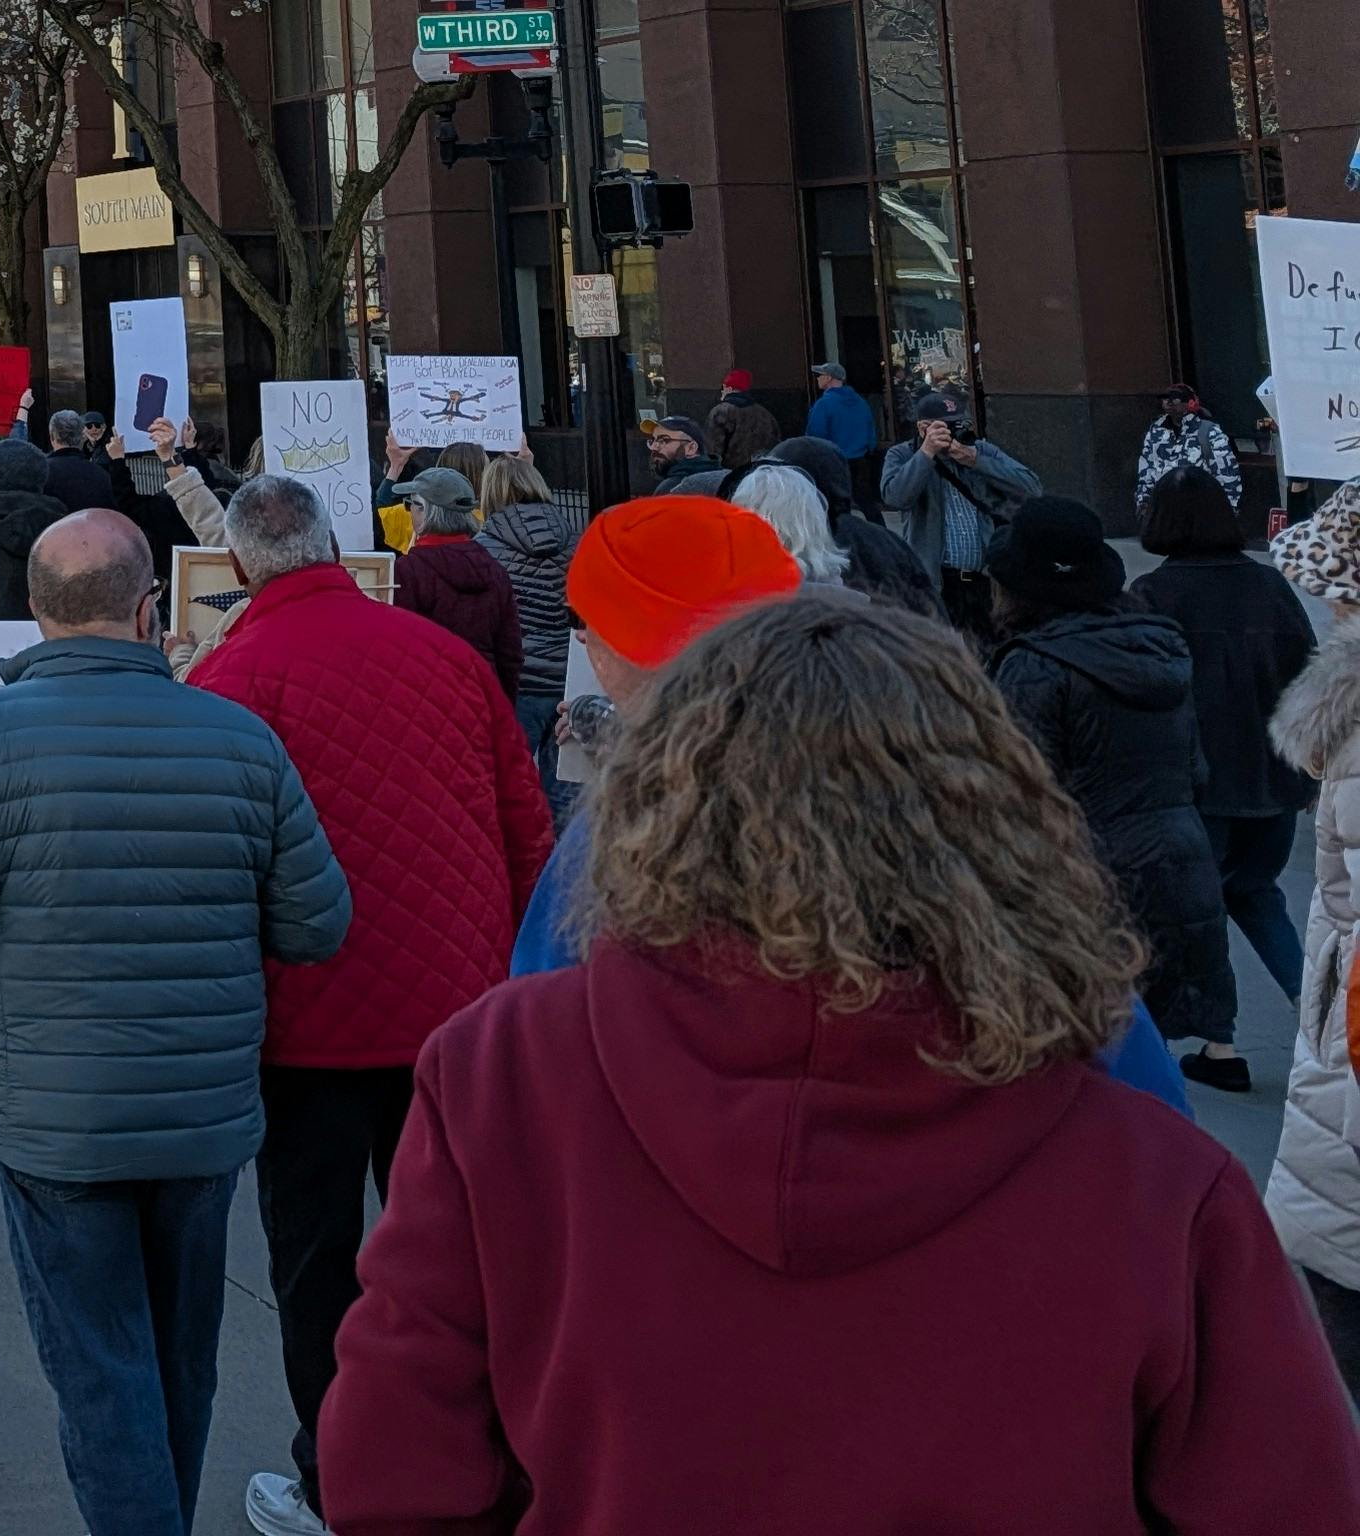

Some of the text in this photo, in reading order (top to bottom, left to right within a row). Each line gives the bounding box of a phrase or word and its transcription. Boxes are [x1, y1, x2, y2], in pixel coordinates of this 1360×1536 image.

[423, 16, 543, 43] W THIRD ST
[525, 29, 549, 42] 1-99
[84, 194, 166, 226] SOUTH MAIN
[575, 277, 592, 290] NO
[1287, 261, 1360, 302] Defu
[389, 356, 425, 368] PUPPET
[414, 367, 433, 378] GOT
[292, 391, 333, 428] NO
[396, 428, 515, 441] AND NOW WE THE PEOPLE
